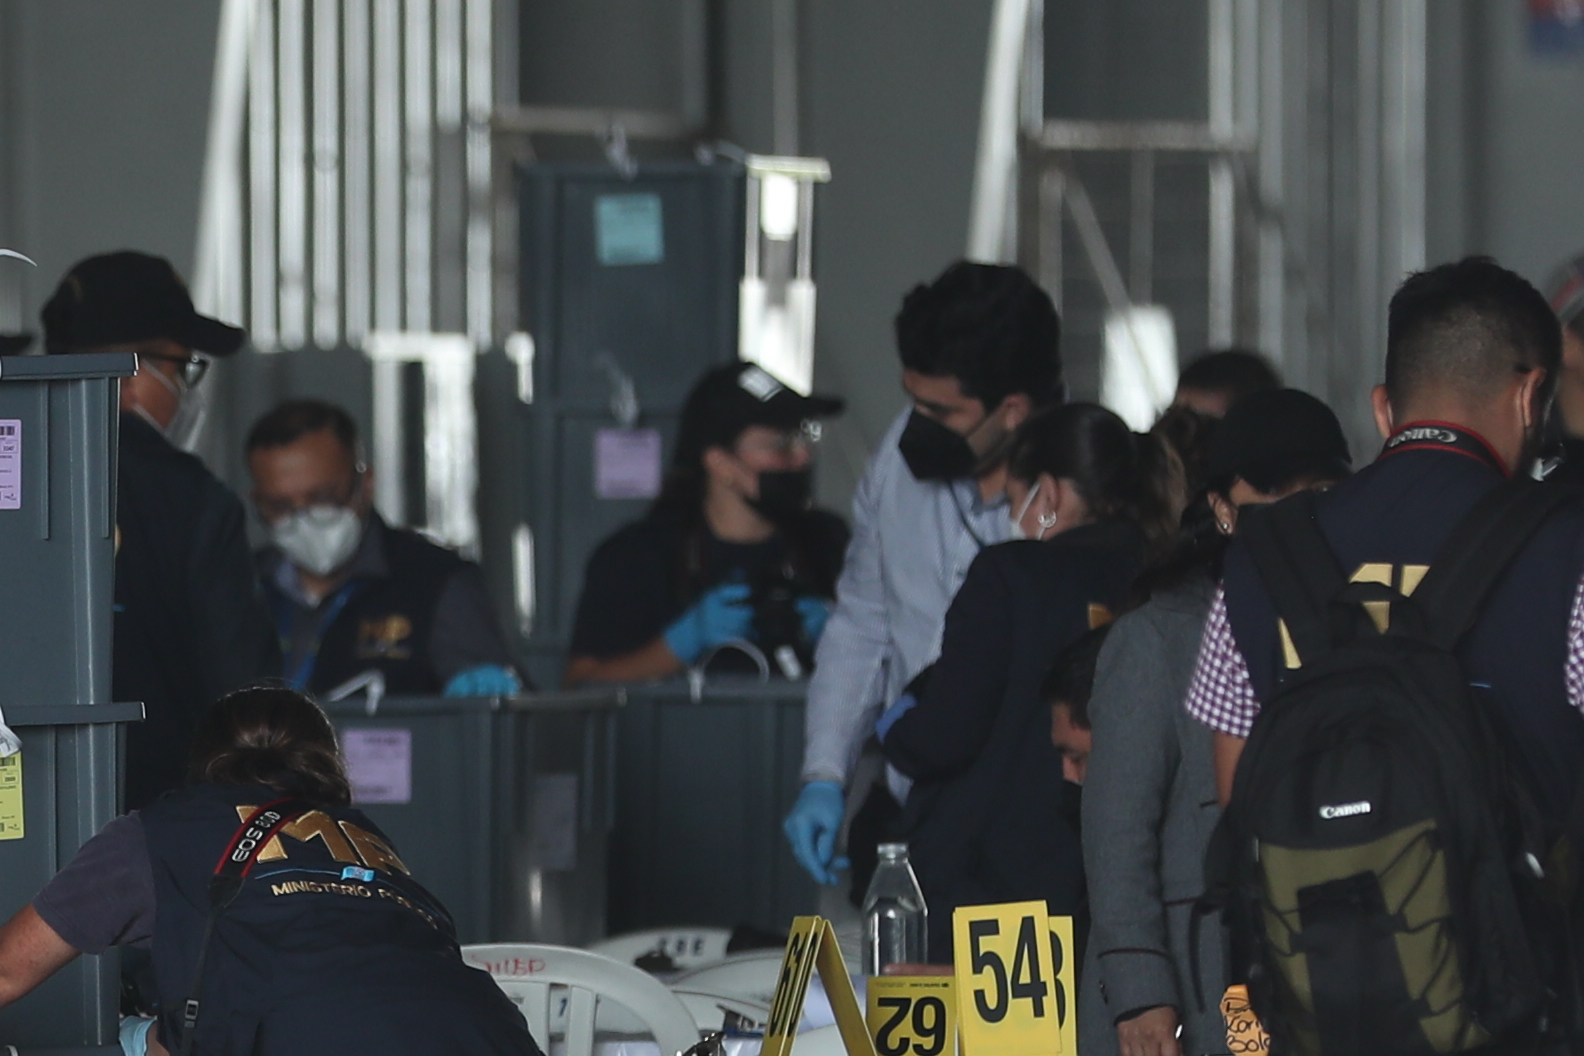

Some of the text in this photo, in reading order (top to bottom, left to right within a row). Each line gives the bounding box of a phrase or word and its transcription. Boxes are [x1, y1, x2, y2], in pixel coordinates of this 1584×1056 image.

[1319, 800, 1371, 819] Canon
[231, 827, 263, 862] EOS
[271, 880, 372, 898] MINISTERIO
[968, 915, 1048, 1024] 54
